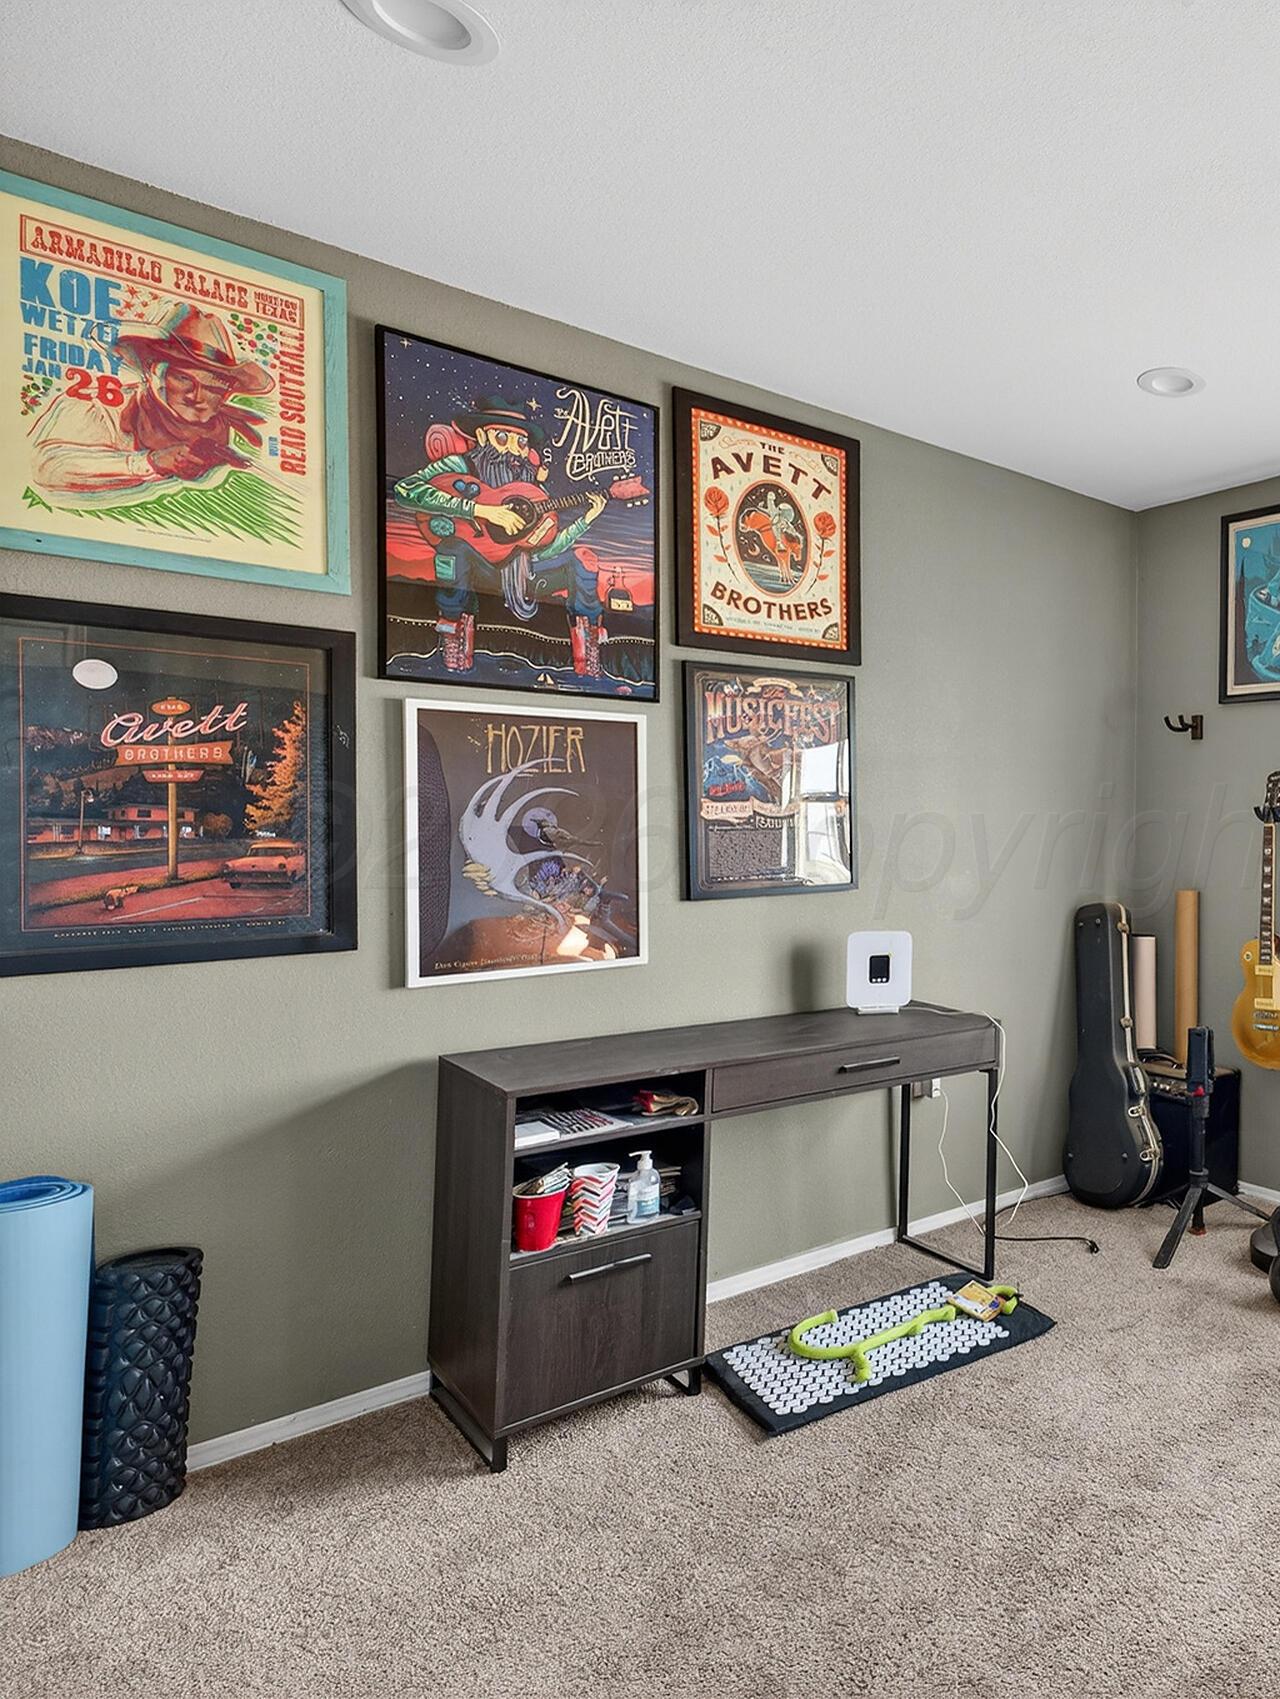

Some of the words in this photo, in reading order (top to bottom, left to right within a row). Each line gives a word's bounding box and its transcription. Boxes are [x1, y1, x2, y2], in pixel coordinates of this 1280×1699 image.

[20, 256, 121, 323] KOE
[31, 226, 162, 283] ARMADILLO
[173, 267, 248, 309] PALACE
[22, 357, 61, 380] JAN
[23, 332, 122, 376] FRIDAY
[65, 367, 124, 408] 26
[278, 332, 305, 424] SOUTHALL
[759, 441, 785, 454] THE
[710, 452, 831, 500] AVETT
[710, 581, 833, 621] BROTHERS
[124, 747, 224, 761] BROTHERS
[486, 723, 586, 775] HOZIER
